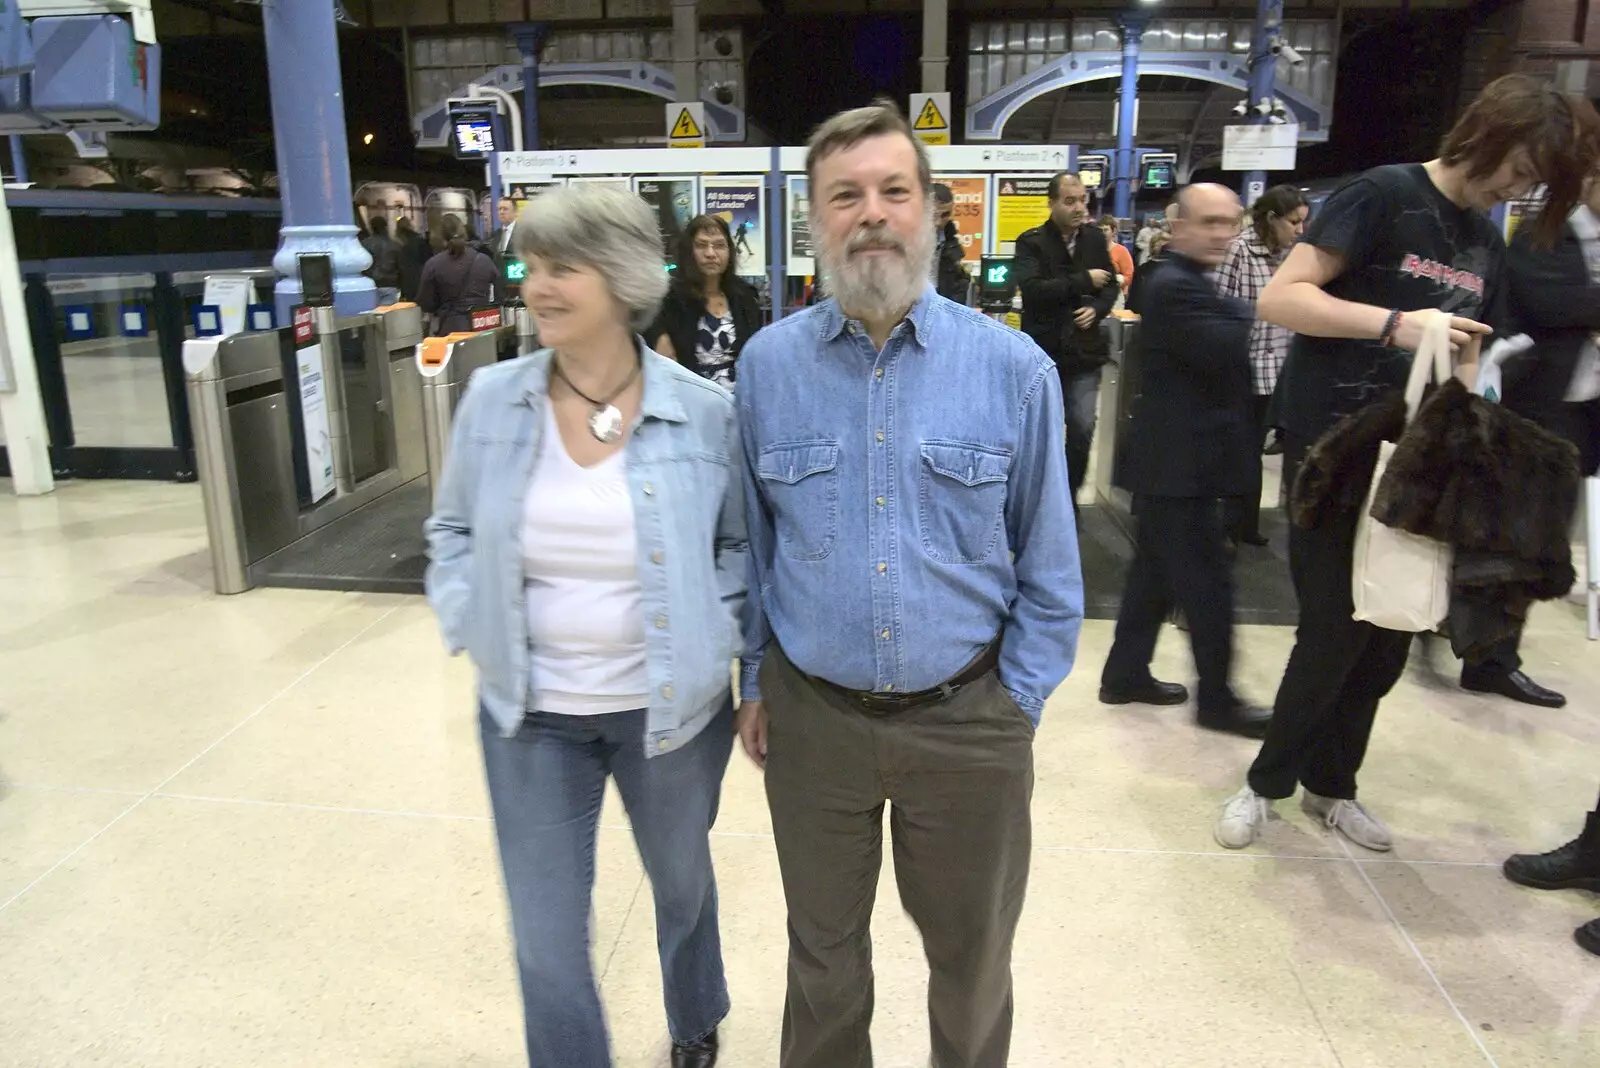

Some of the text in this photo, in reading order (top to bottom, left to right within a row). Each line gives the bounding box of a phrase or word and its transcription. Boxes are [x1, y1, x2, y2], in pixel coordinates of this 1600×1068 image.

[516, 154, 565, 166] Platform 3
[996, 150, 1049, 161] Platform 2
[707, 192, 756, 201] All the magic
